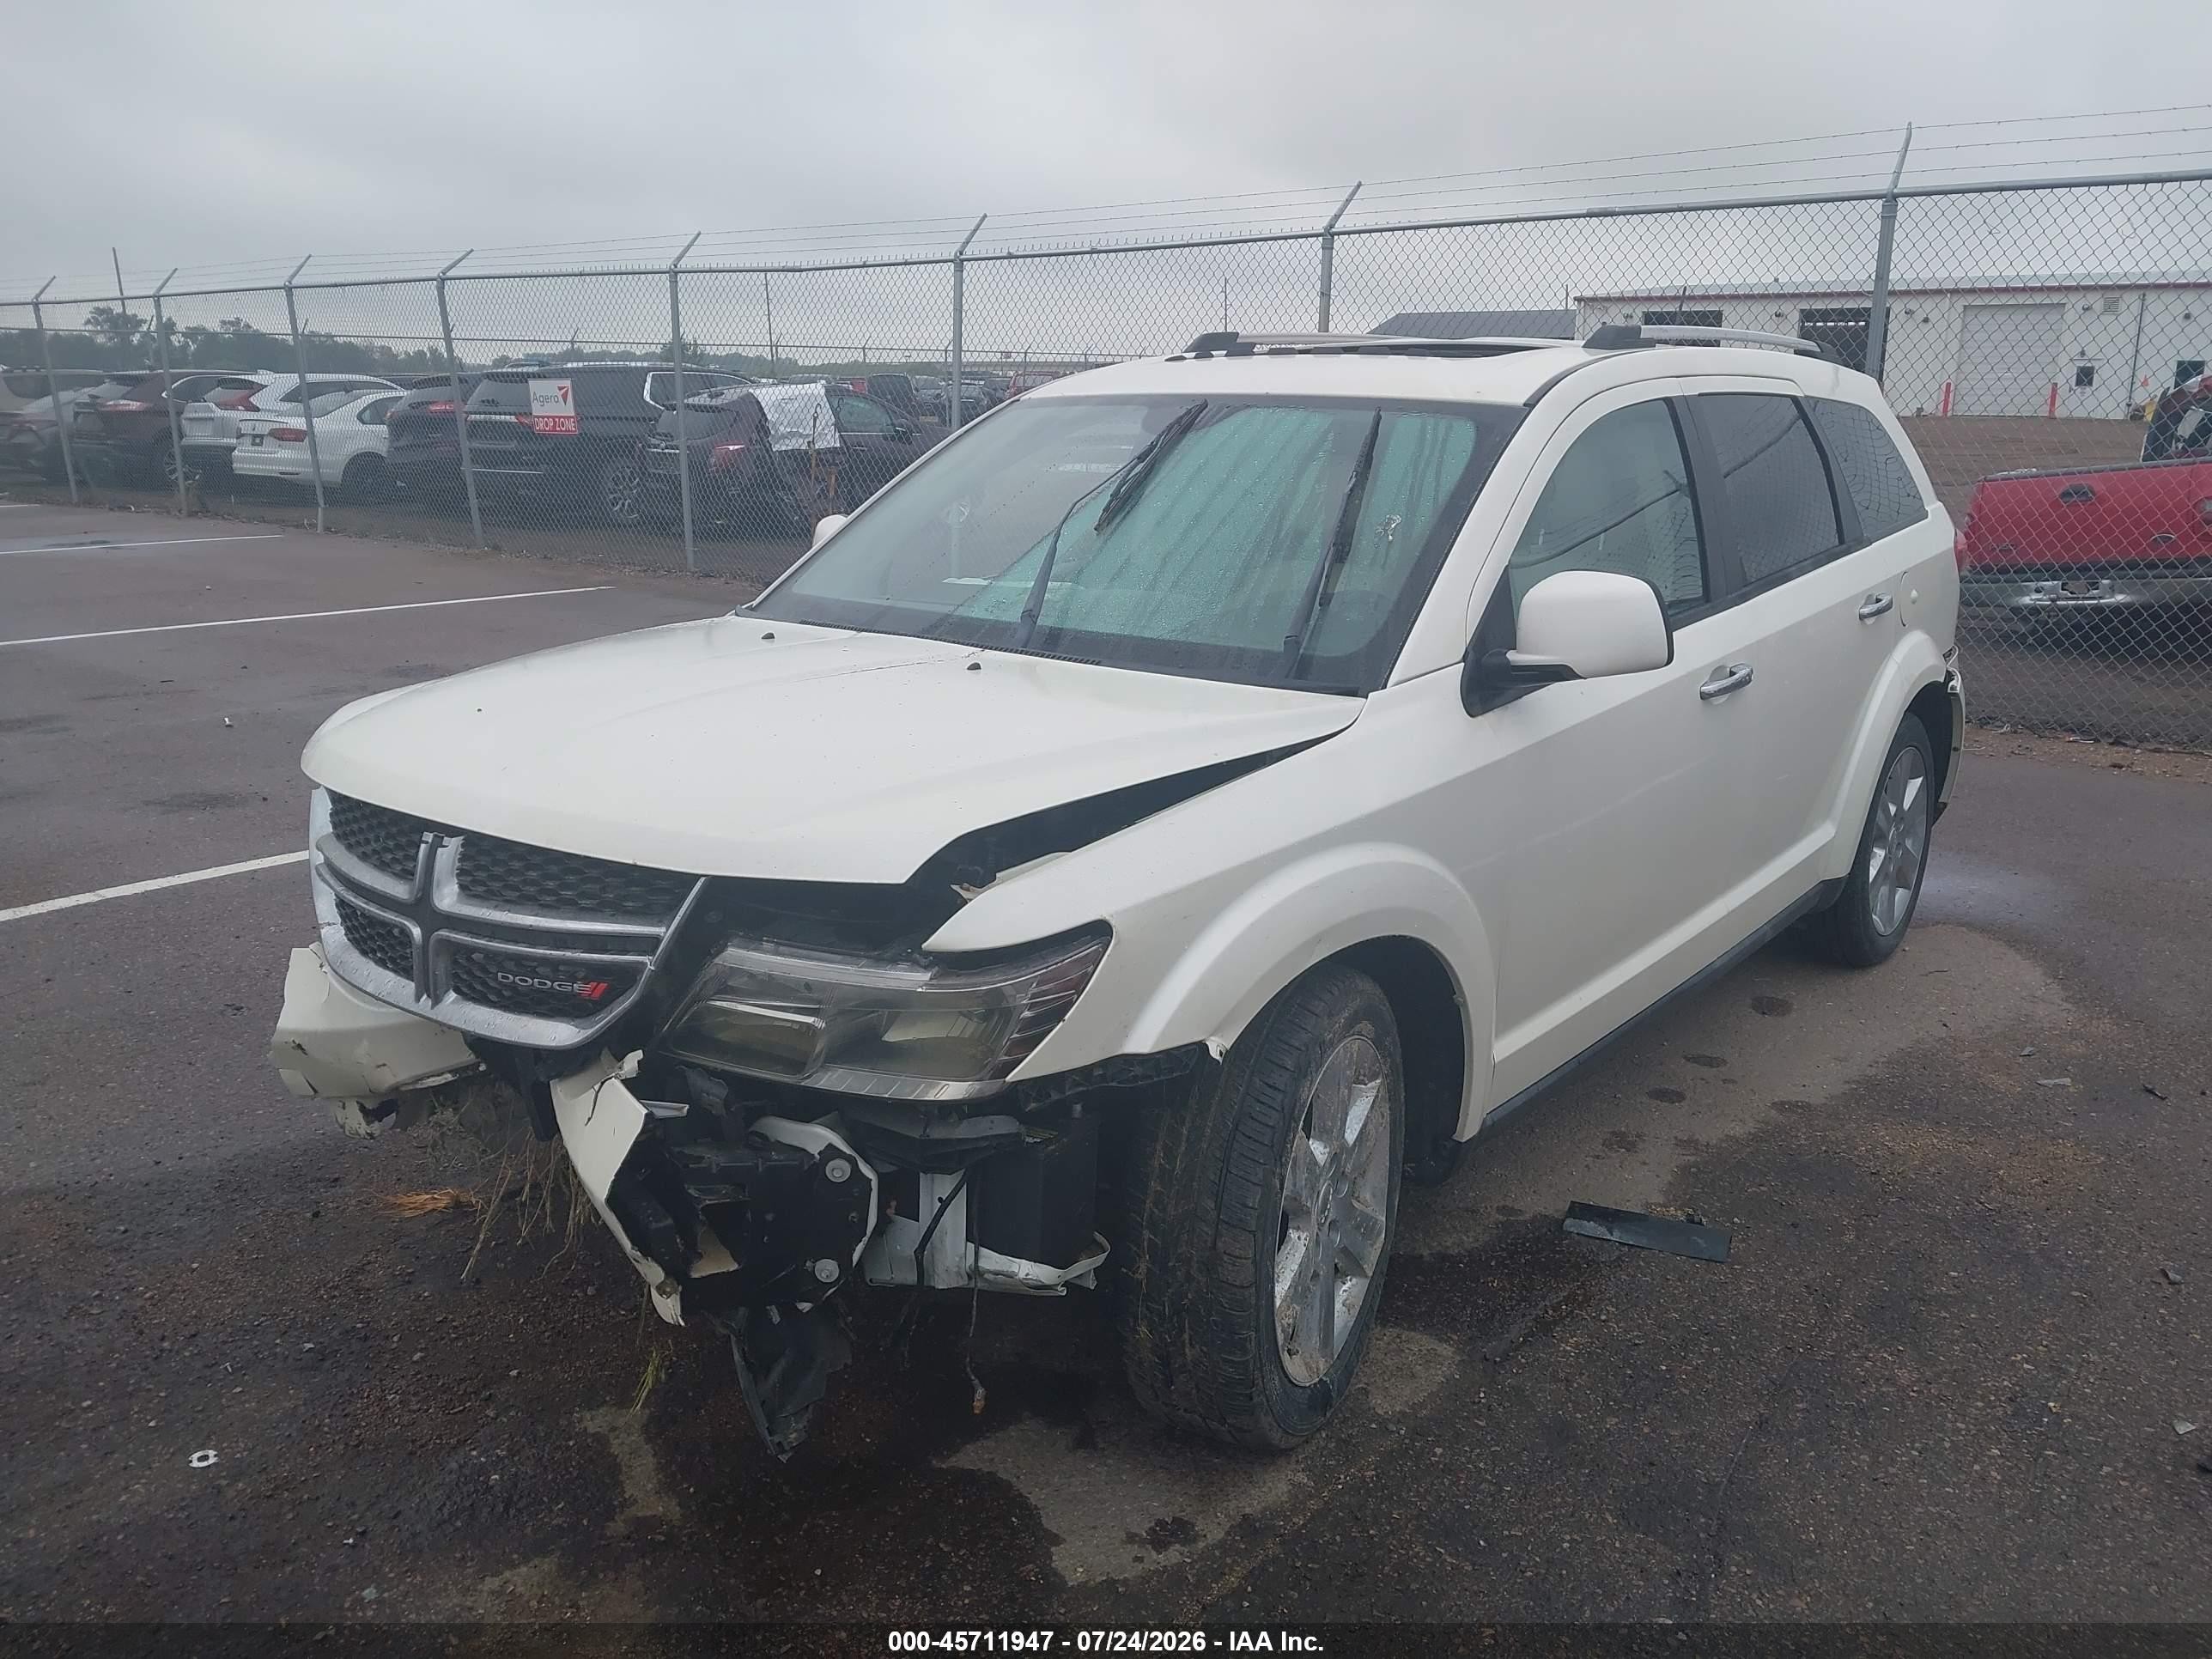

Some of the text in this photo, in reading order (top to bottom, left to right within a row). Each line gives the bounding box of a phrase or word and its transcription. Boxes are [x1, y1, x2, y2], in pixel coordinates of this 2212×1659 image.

[532, 391, 559, 406] Agero
[534, 417, 576, 431] DROP ZONE
[496, 971, 592, 995] DODGE
